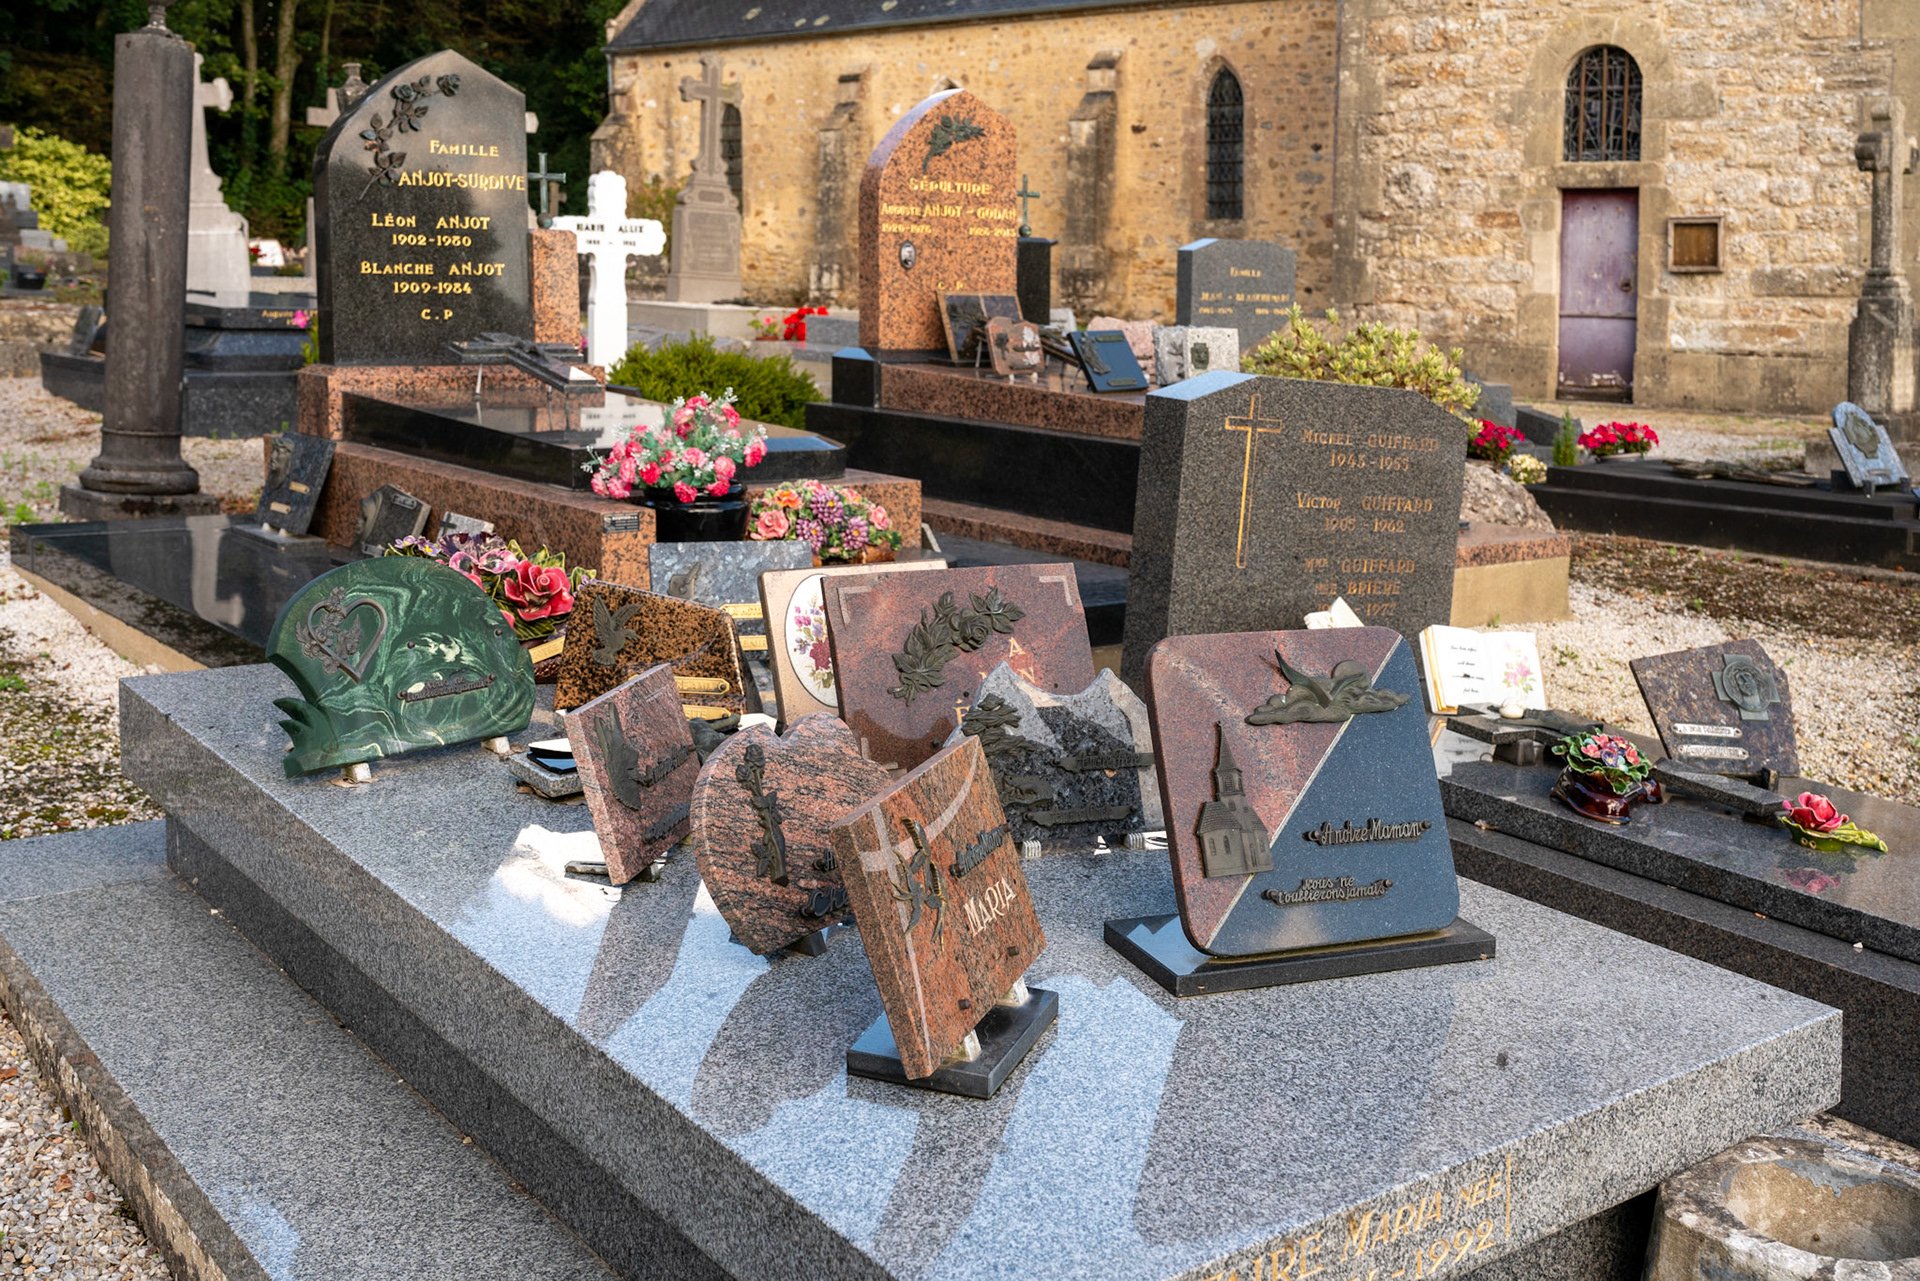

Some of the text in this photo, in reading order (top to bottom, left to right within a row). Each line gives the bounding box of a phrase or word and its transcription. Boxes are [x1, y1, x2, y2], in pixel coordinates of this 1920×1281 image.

[398, 169, 526, 191] ANJOT-SURDIVE
[436, 214, 490, 230] ANJOT
[449, 262, 505, 276] ANJOT
[1368, 818, 1420, 842] Maman
[963, 877, 1017, 937] MARIA
[1339, 1190, 1442, 1263] MARIA
[1456, 1172, 1503, 1213] NÉE
